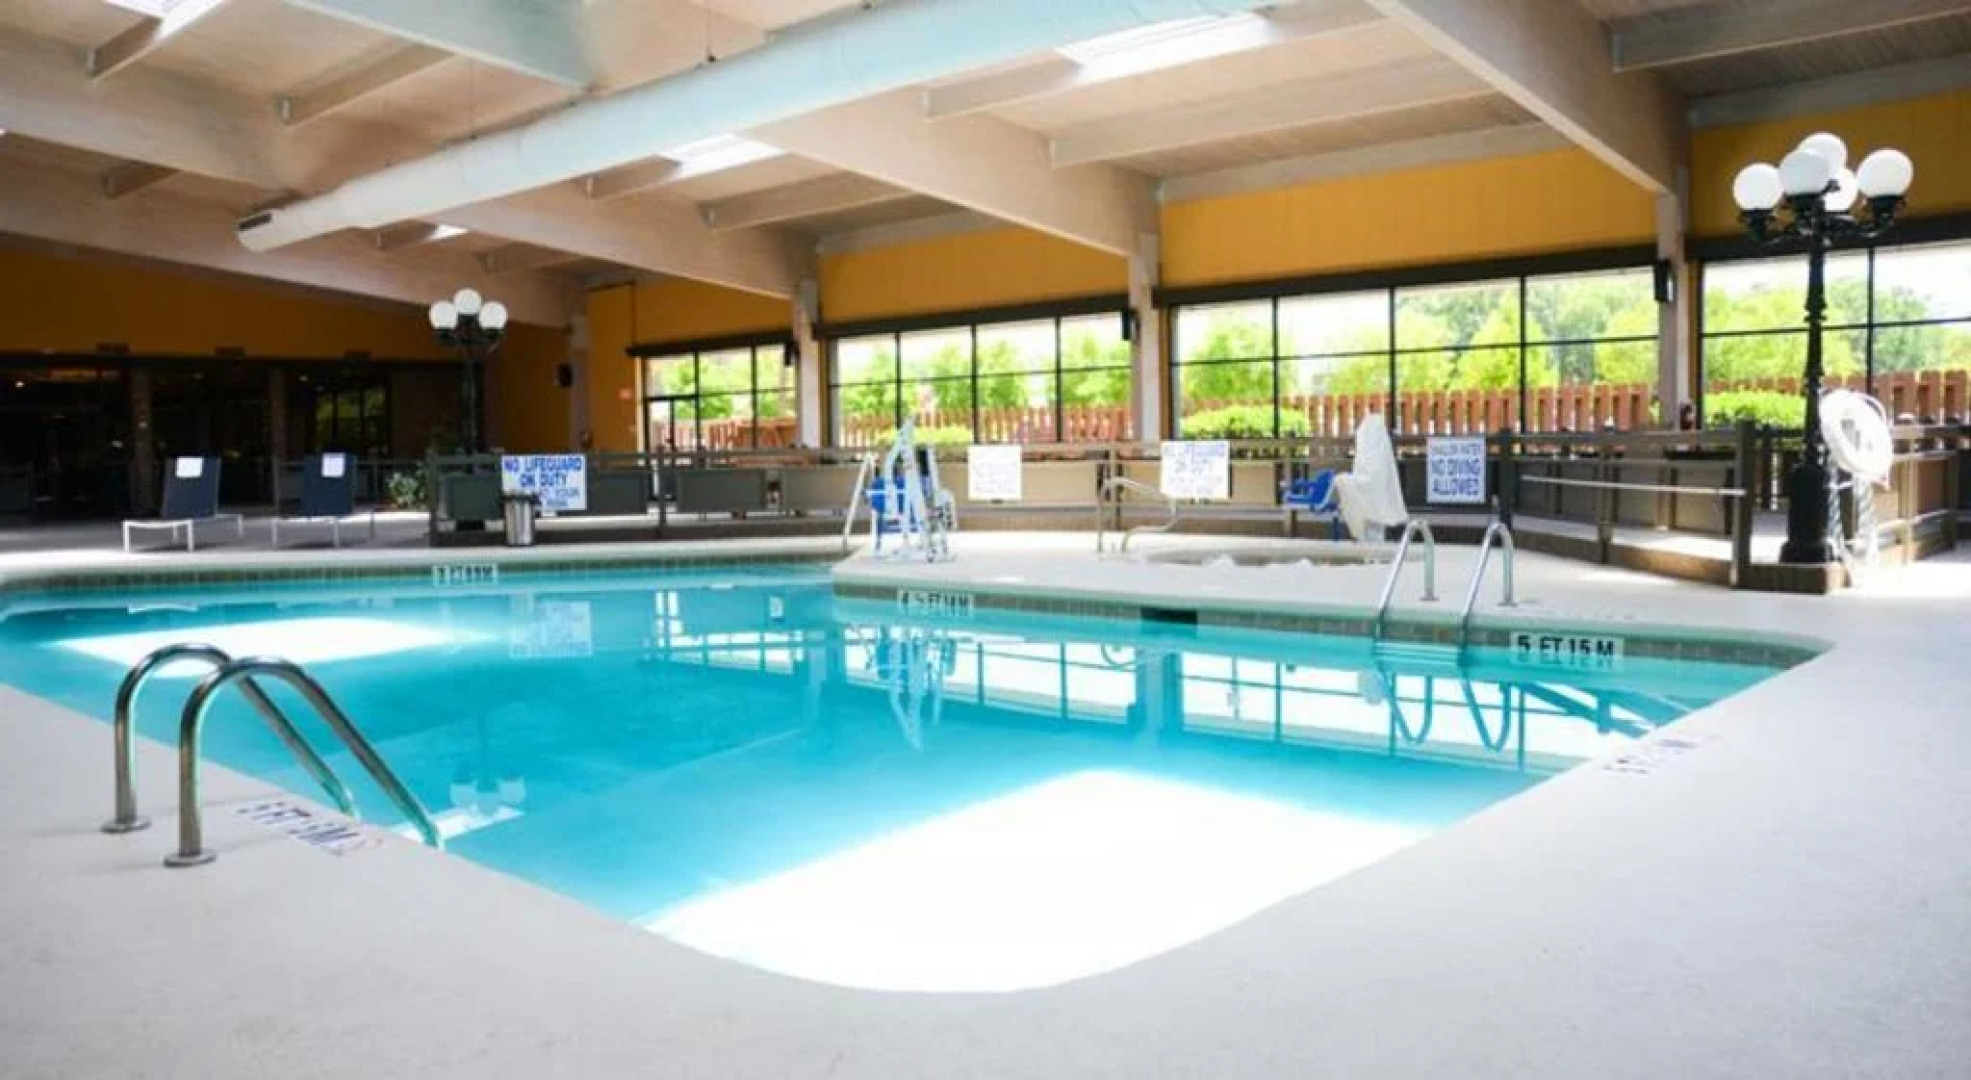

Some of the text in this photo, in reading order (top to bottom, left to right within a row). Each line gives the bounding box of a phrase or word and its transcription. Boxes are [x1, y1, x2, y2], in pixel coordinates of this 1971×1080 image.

[503, 457, 582, 473] NO LIFEGUARD
[1432, 458, 1481, 475] NO DIVING
[520, 472, 567, 487] ON DUTY
[1432, 478, 1479, 496] ALLOWED
[1540, 636, 1563, 653] FT
[1596, 640, 1614, 657] M
